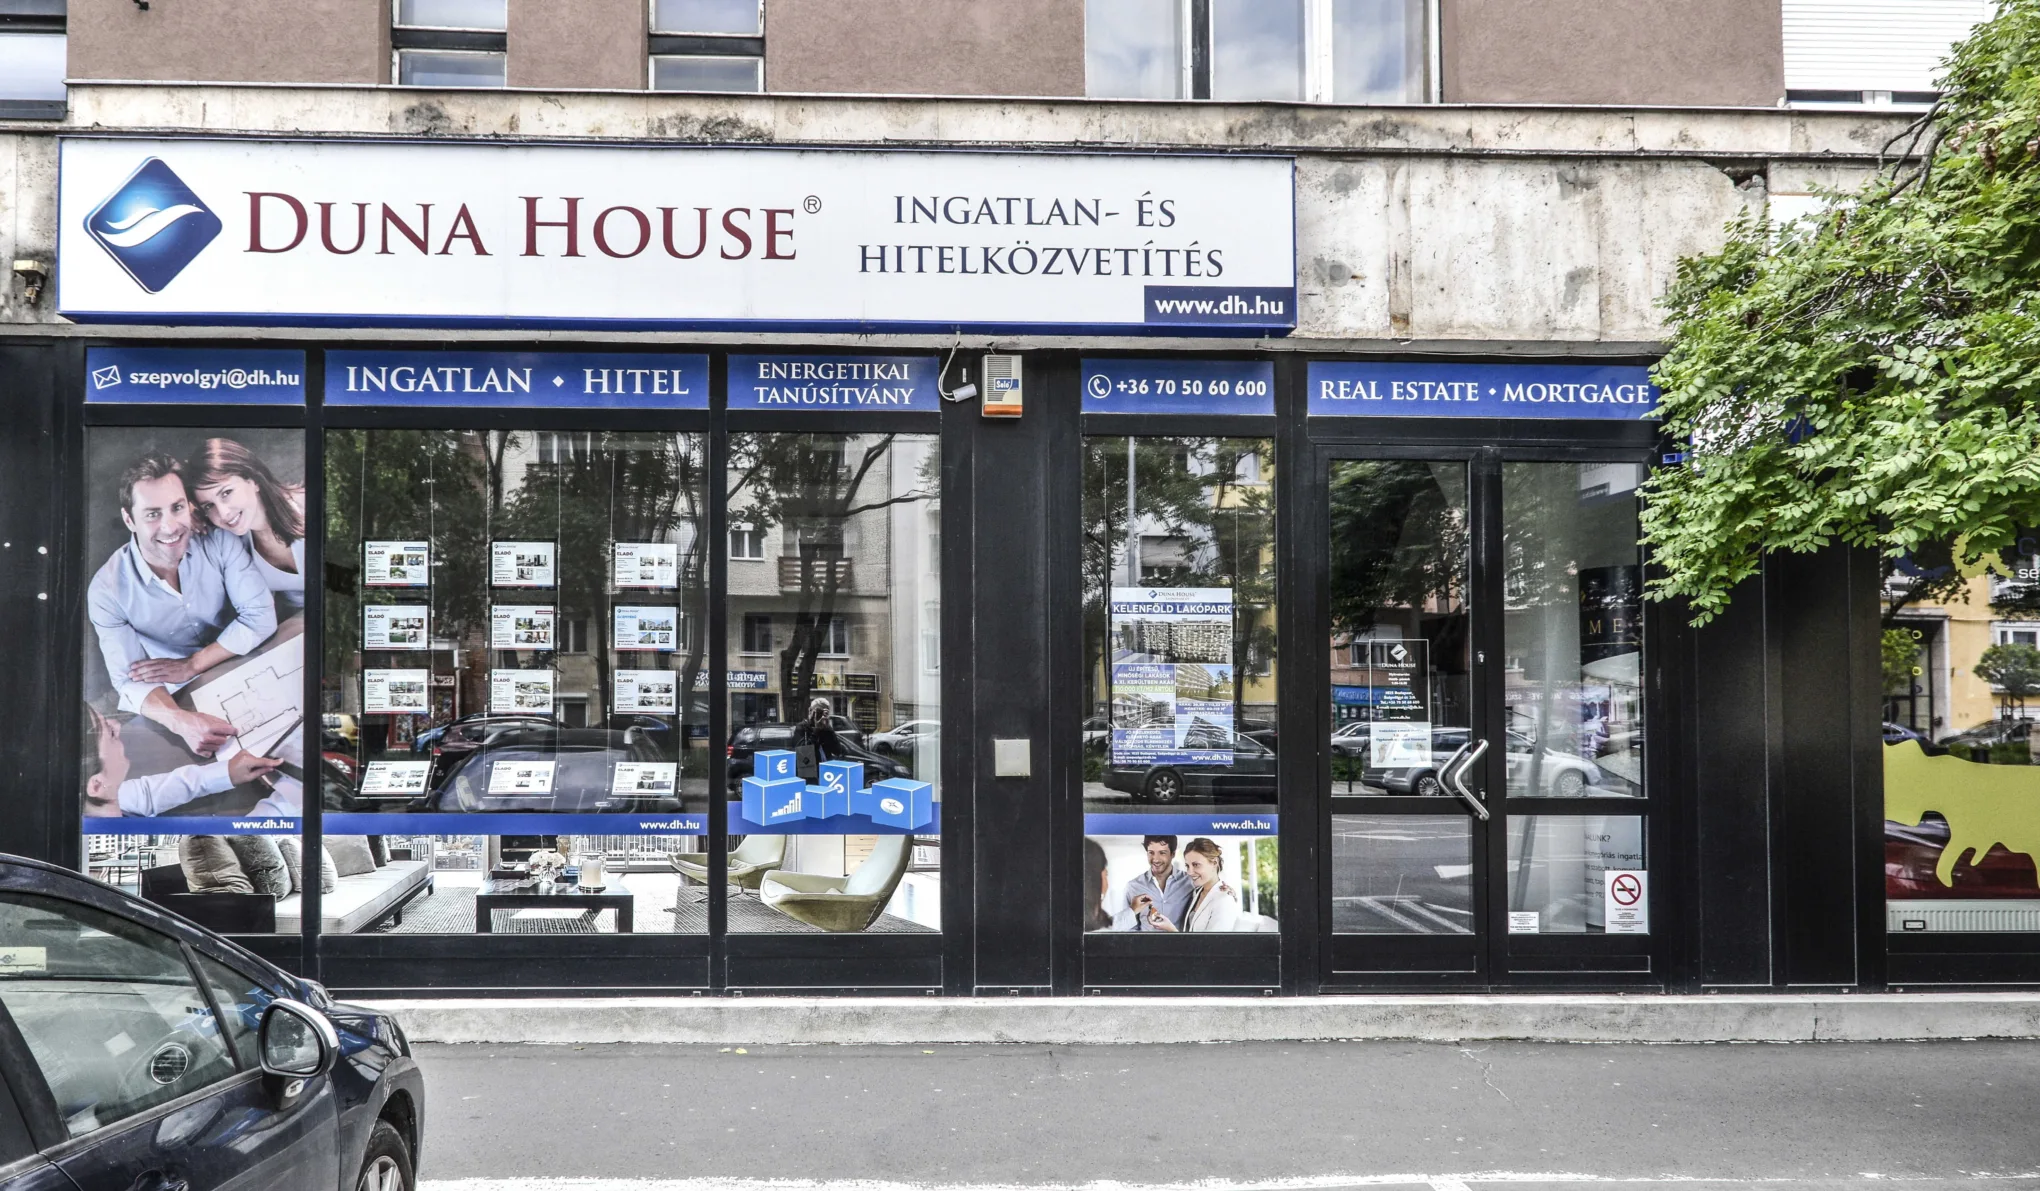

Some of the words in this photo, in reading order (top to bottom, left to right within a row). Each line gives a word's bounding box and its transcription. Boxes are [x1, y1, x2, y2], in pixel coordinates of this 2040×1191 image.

[894, 195, 1119, 227] INGATLAN-
[1136, 191, 1176, 228] ÉS
[242, 191, 493, 256] DUNA
[858, 239, 1224, 278] HITELKÖZVETÍTÉS
[1154, 295, 1284, 315] www.dh.hu
[129, 368, 300, 390] szepvolgyi@dh.hu
[346, 366, 532, 394] INGATLAN
[583, 368, 690, 395] HITEL
[758, 362, 909, 381] ENERGETIKAI
[753, 380, 915, 405] TANÚSÍTVÁNY
[1115, 379, 1150, 397] +36
[1155, 379, 1177, 397] 70
[1181, 379, 1202, 397] 50
[1208, 379, 1230, 397] 60
[1234, 379, 1267, 397] 600
[1319, 380, 1383, 400] REAL
[1391, 381, 1479, 401] ESTATE
[1502, 383, 1650, 404] MORTGAGE
[1113, 602, 1174, 613] KELENFÖLD
[1176, 602, 1232, 613] LAKÓPARK
[232, 820, 295, 830] www.dh.hu
[639, 819, 700, 830] www.dh.hu
[1211, 820, 1271, 830] www.dh.hu
